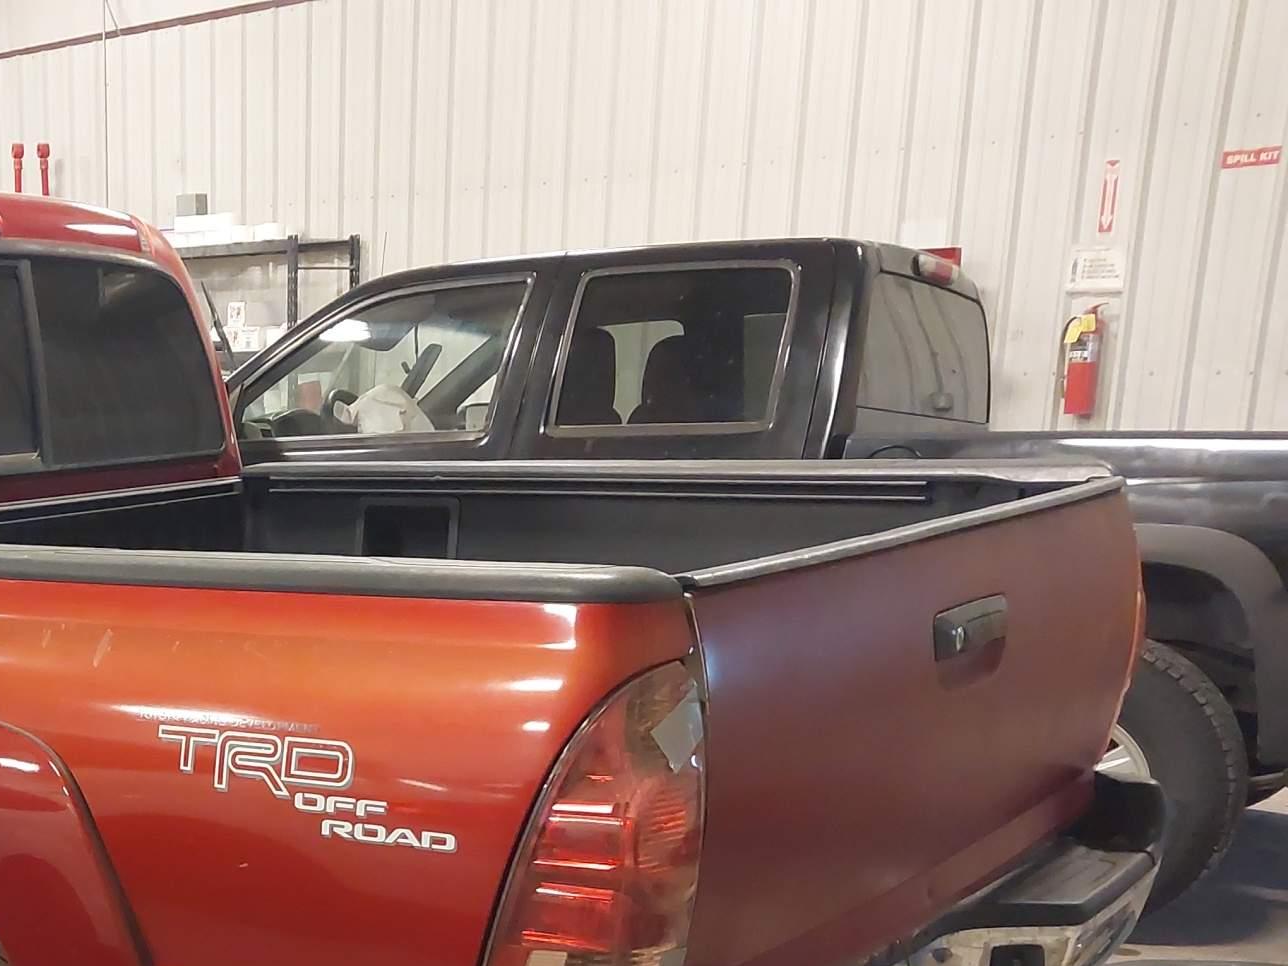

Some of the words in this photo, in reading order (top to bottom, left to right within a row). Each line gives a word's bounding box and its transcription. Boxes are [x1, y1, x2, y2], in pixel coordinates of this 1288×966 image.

[1226, 152, 1257, 164] SPILL
[1259, 150, 1281, 161] KIT
[158, 724, 355, 799] TRD
[294, 792, 389, 818] OFF
[321, 819, 458, 854] ROAD
